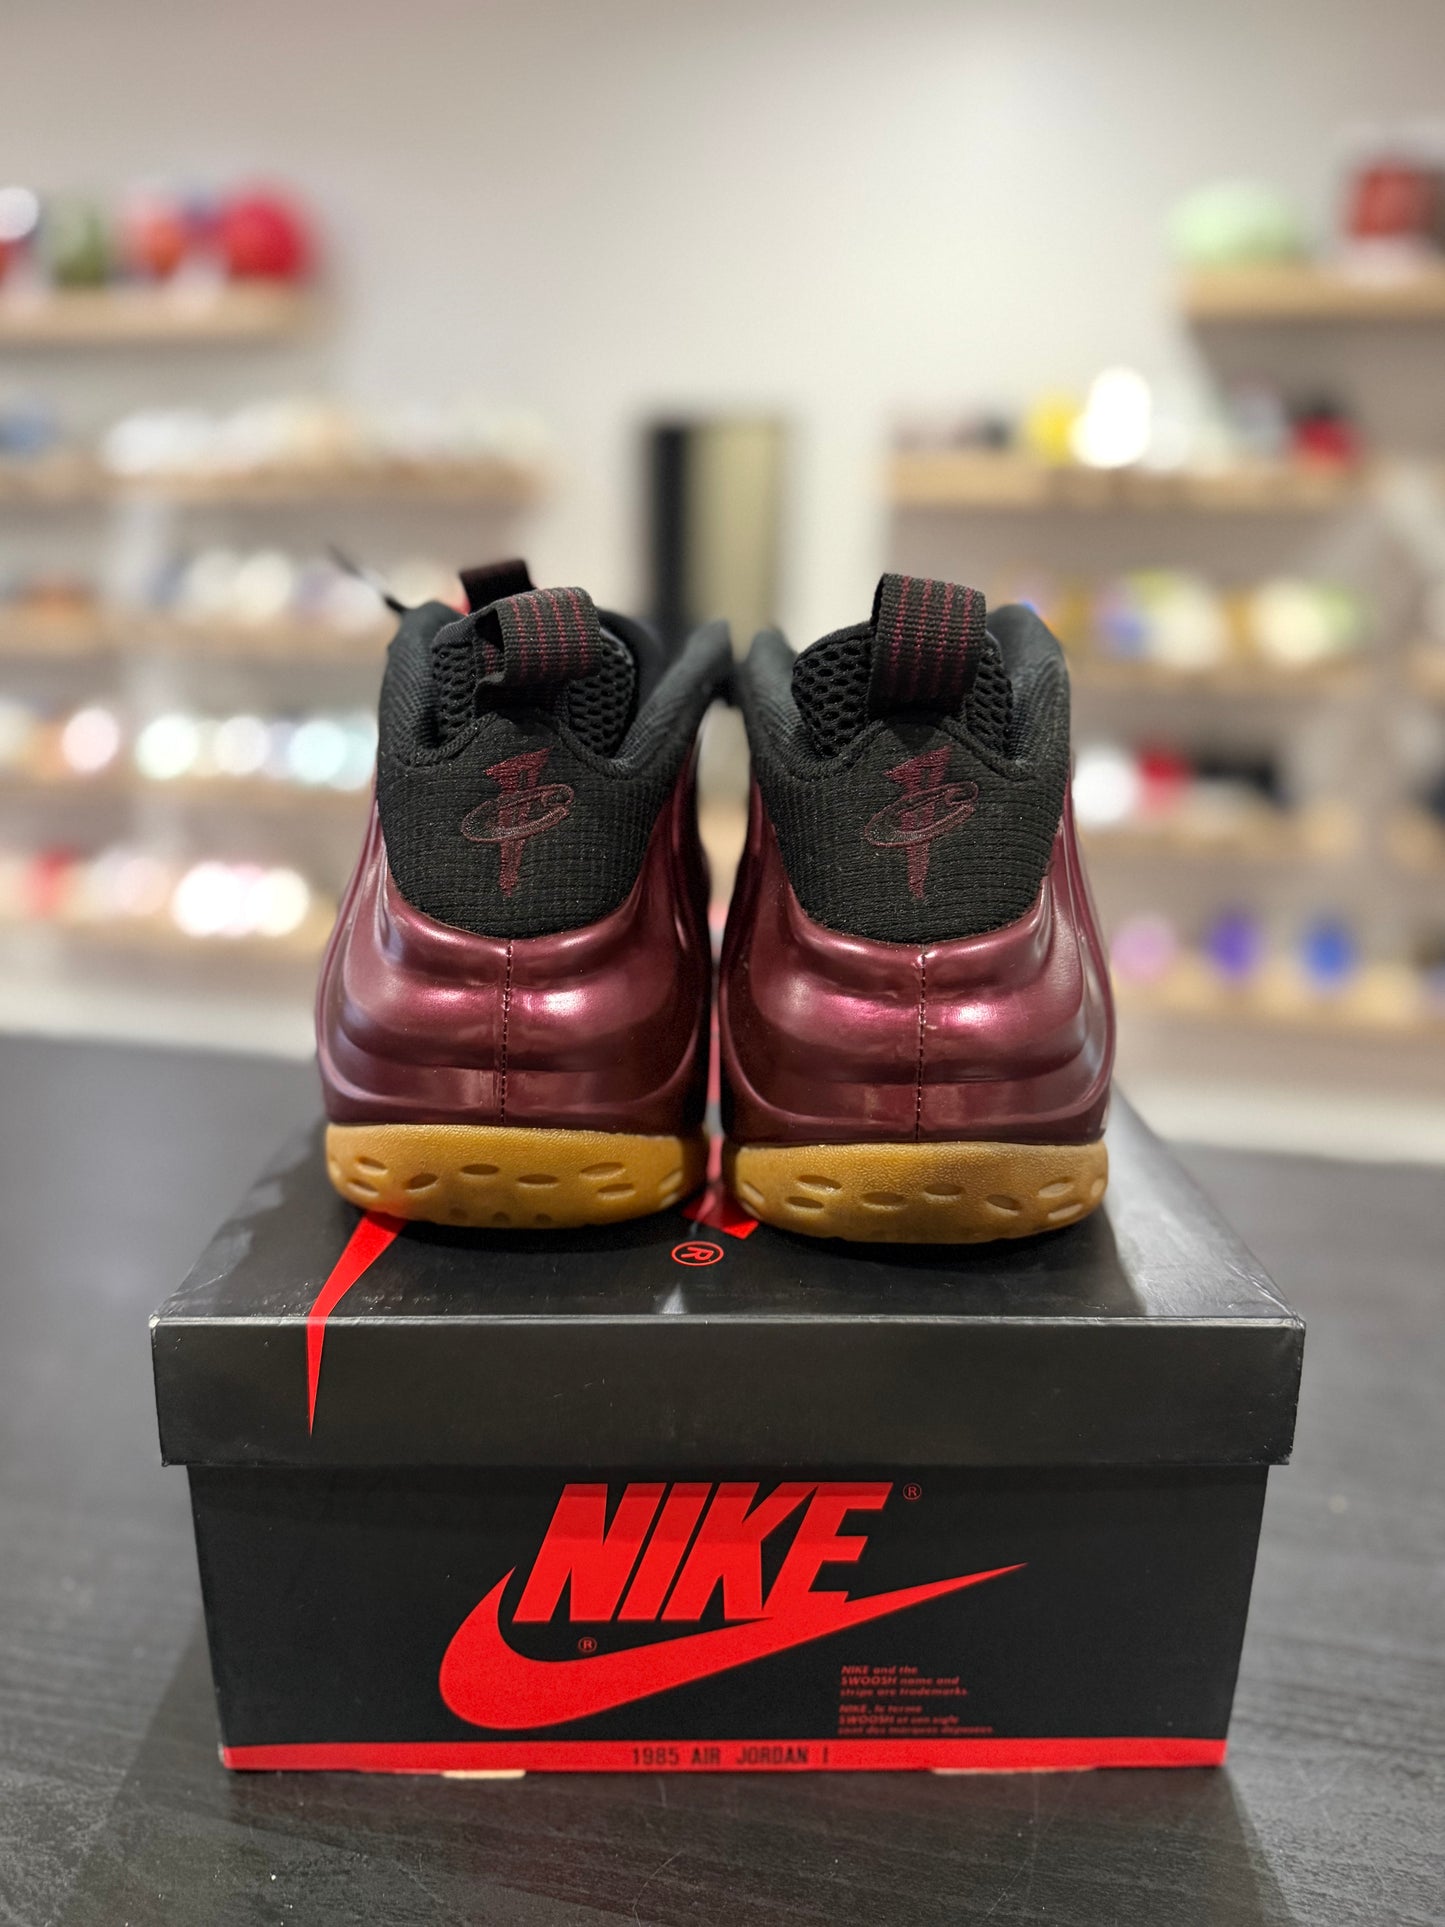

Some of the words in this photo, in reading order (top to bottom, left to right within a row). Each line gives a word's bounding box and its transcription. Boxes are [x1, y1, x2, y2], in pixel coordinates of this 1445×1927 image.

[512, 1481, 893, 1623] NIKE
[841, 1665, 869, 1675] NIKE
[873, 1665, 896, 1675] and
[899, 1665, 918, 1675] the
[841, 1676, 897, 1686] SWOOSH
[936, 1676, 960, 1686] and
[877, 1688, 896, 1697] are
[839, 1715, 894, 1725] SWOOSH
[632, 1747, 680, 1765] 1985
[691, 1747, 721, 1765] AIR
[736, 1746, 809, 1764] JORDAN
